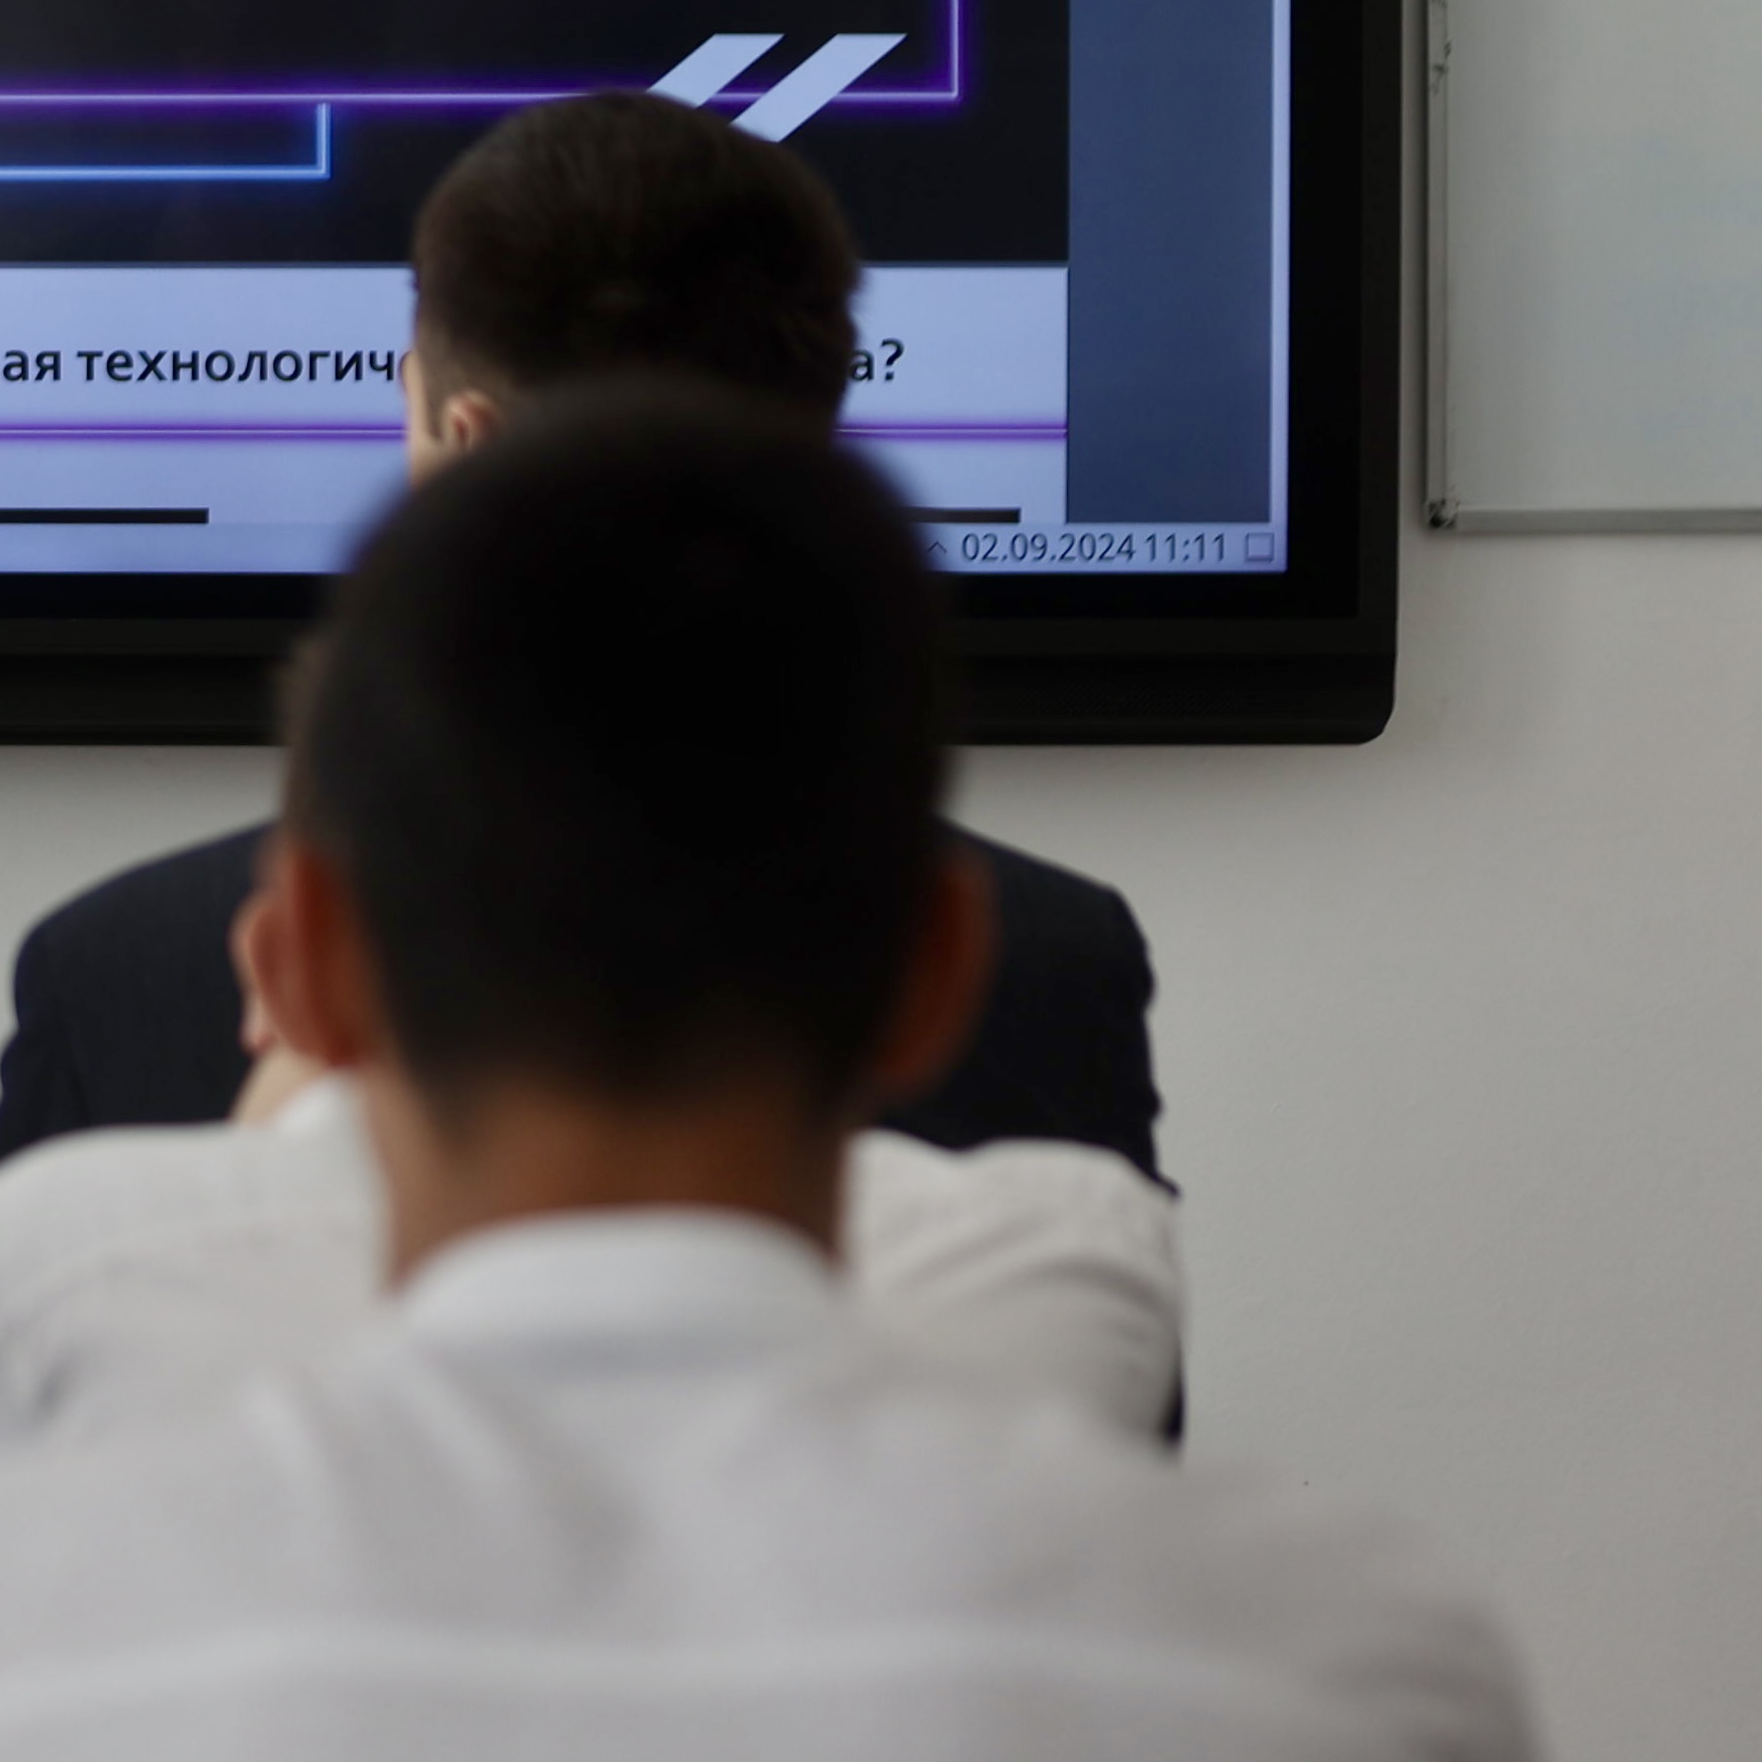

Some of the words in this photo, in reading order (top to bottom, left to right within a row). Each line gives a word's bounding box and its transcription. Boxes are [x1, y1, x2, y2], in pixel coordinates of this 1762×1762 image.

[76, 348, 403, 384] технологич
[961, 532, 1137, 563] 02.09.2024
[1145, 532, 1226, 563] 11:11
